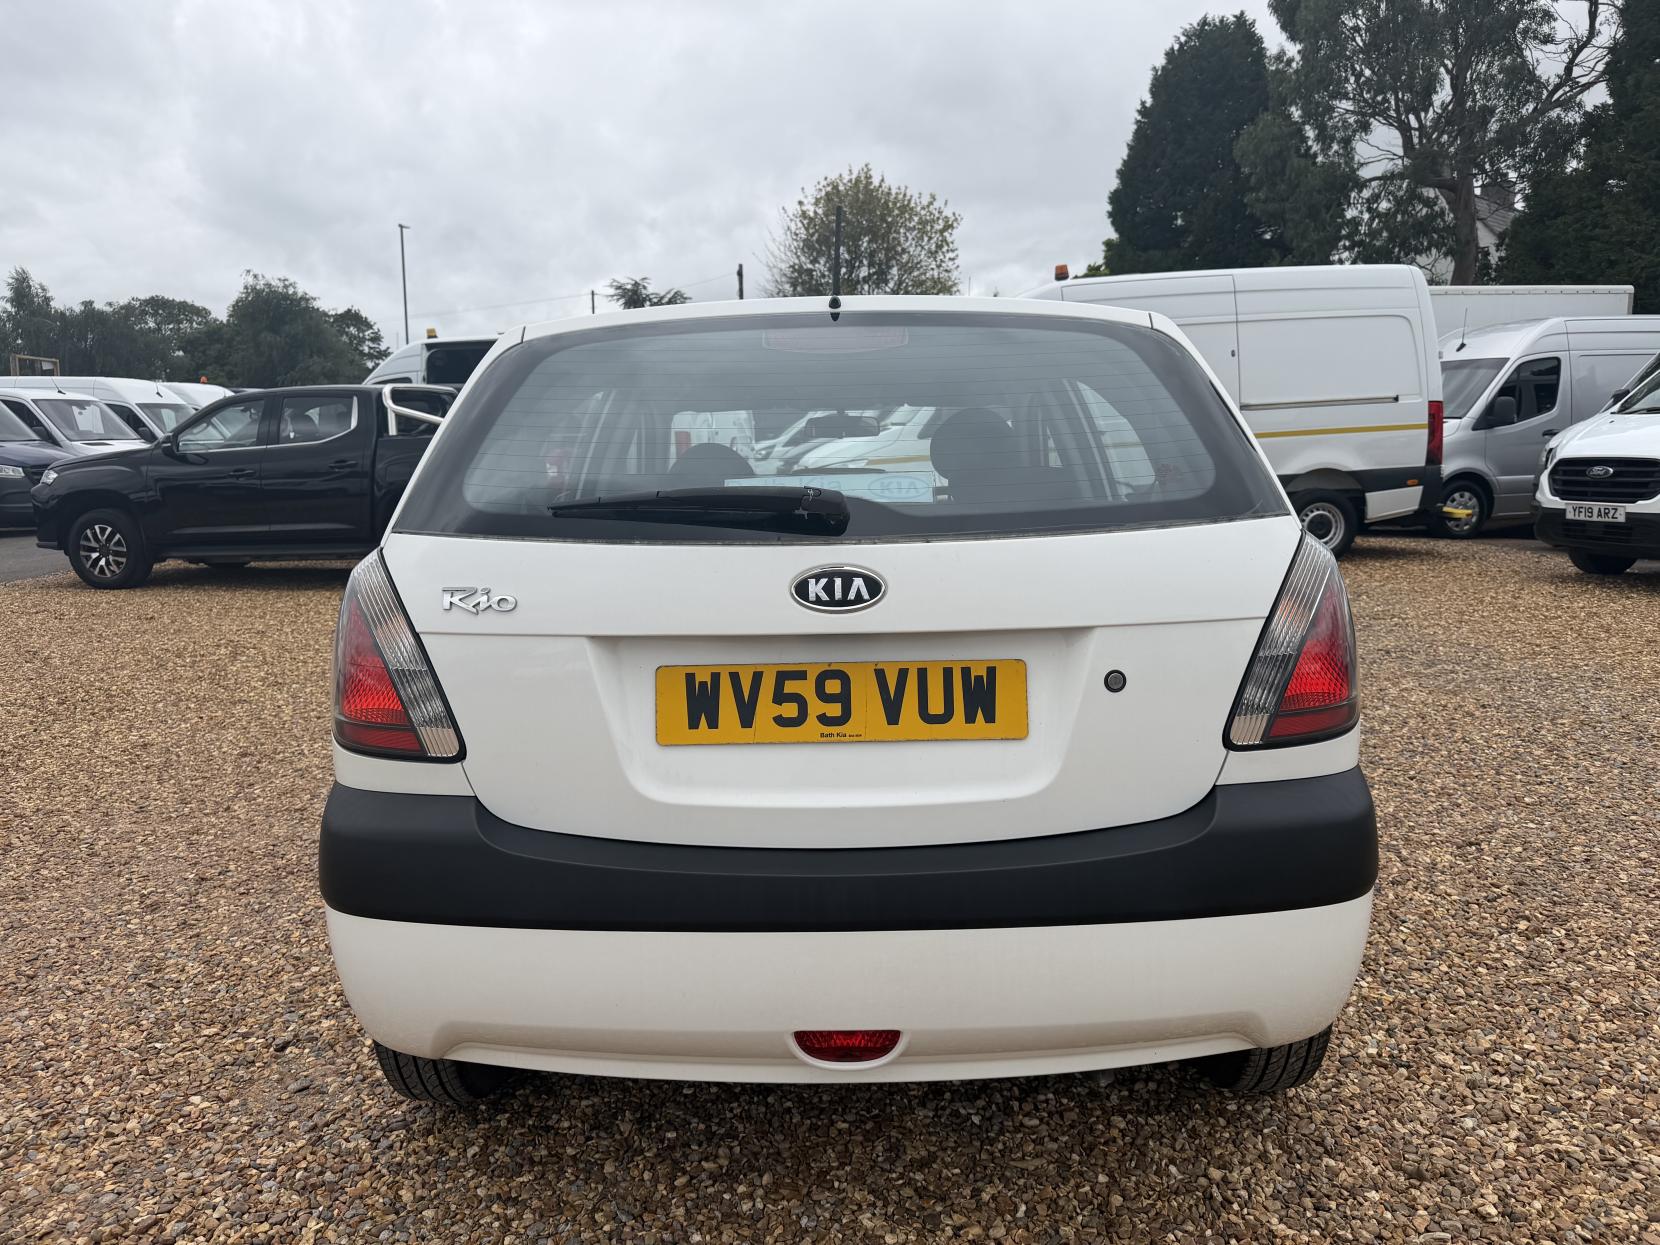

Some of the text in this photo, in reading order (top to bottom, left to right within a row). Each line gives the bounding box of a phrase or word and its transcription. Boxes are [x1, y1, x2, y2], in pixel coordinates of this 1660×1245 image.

[880, 481, 920, 495] KIA
[1571, 505, 1618, 520] YF19 ARZ
[441, 586, 518, 616] Rio
[807, 577, 871, 601] KIA
[684, 666, 997, 730] WV59 VUW
